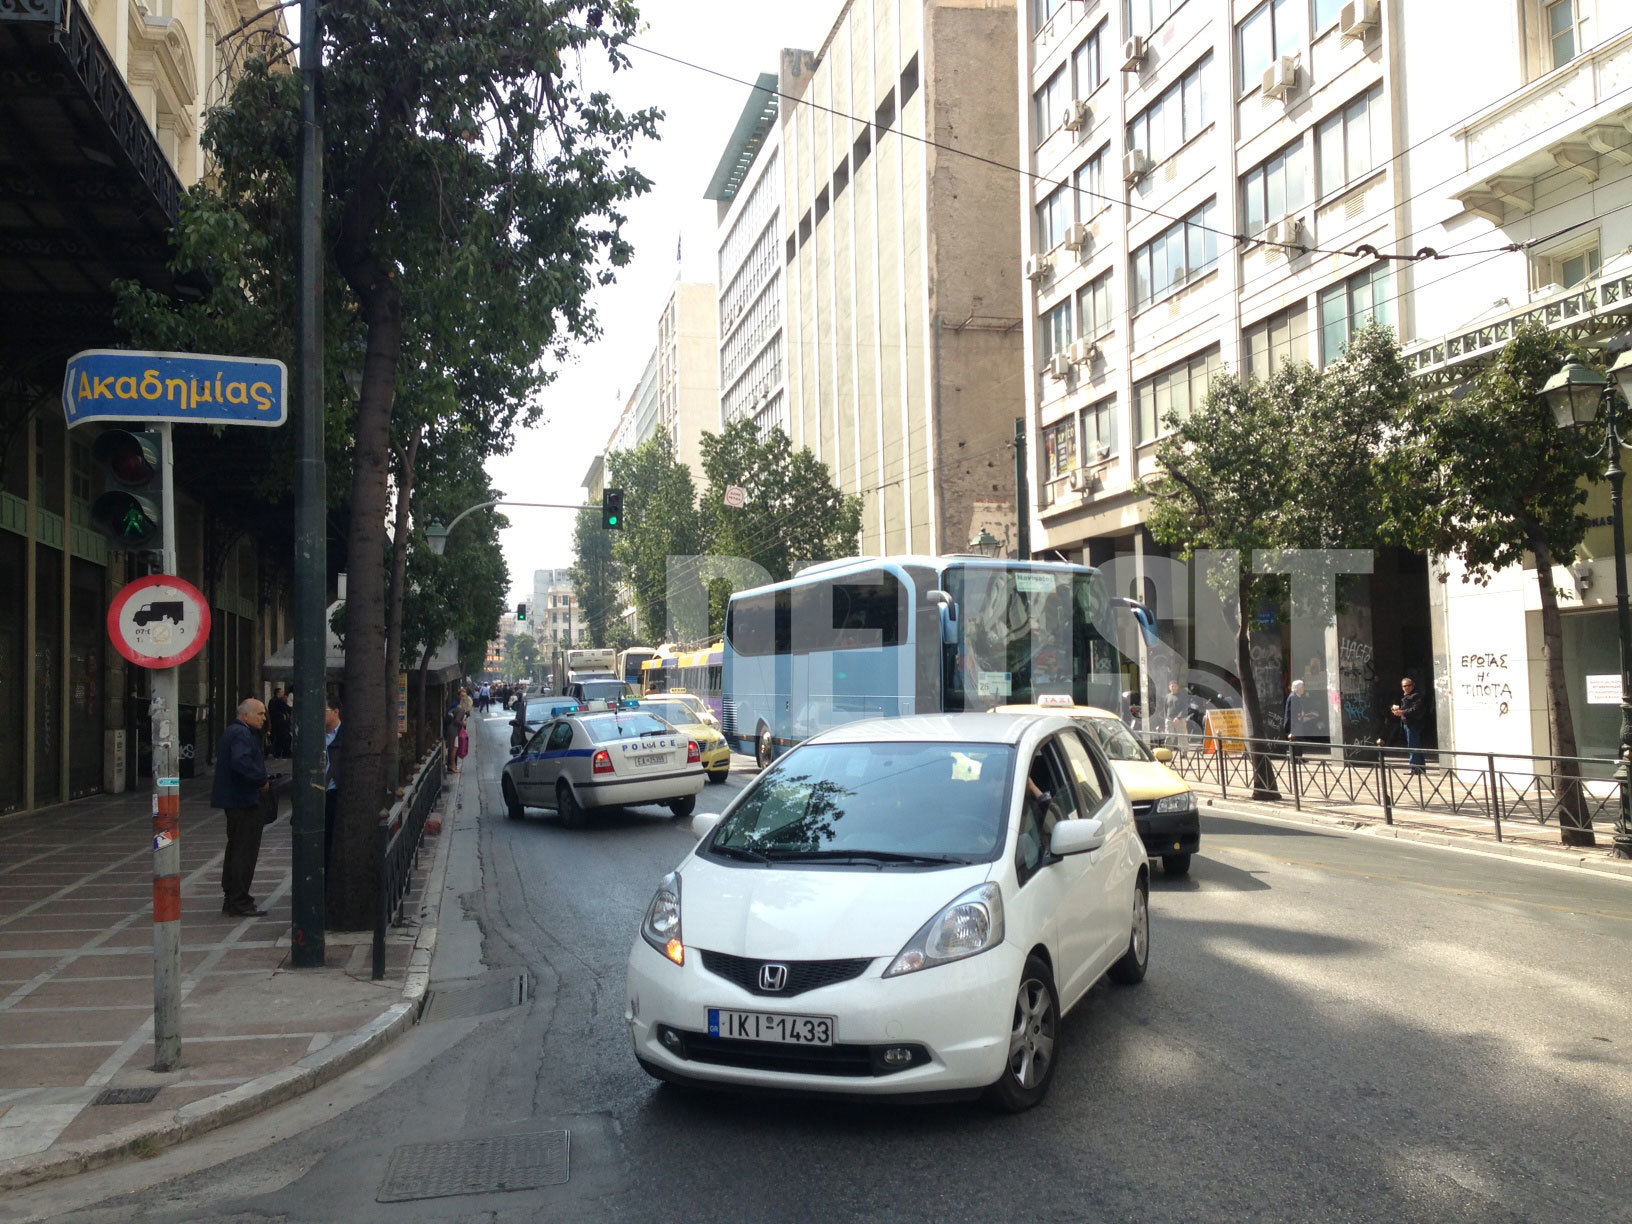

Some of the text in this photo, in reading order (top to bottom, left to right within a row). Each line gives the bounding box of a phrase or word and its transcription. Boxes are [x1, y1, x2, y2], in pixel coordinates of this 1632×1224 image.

[78, 369, 273, 411] Ακαδημίας
[1461, 683, 1512, 699] ΤΙΠΟΤΑ
[622, 740, 676, 752] POLICE
